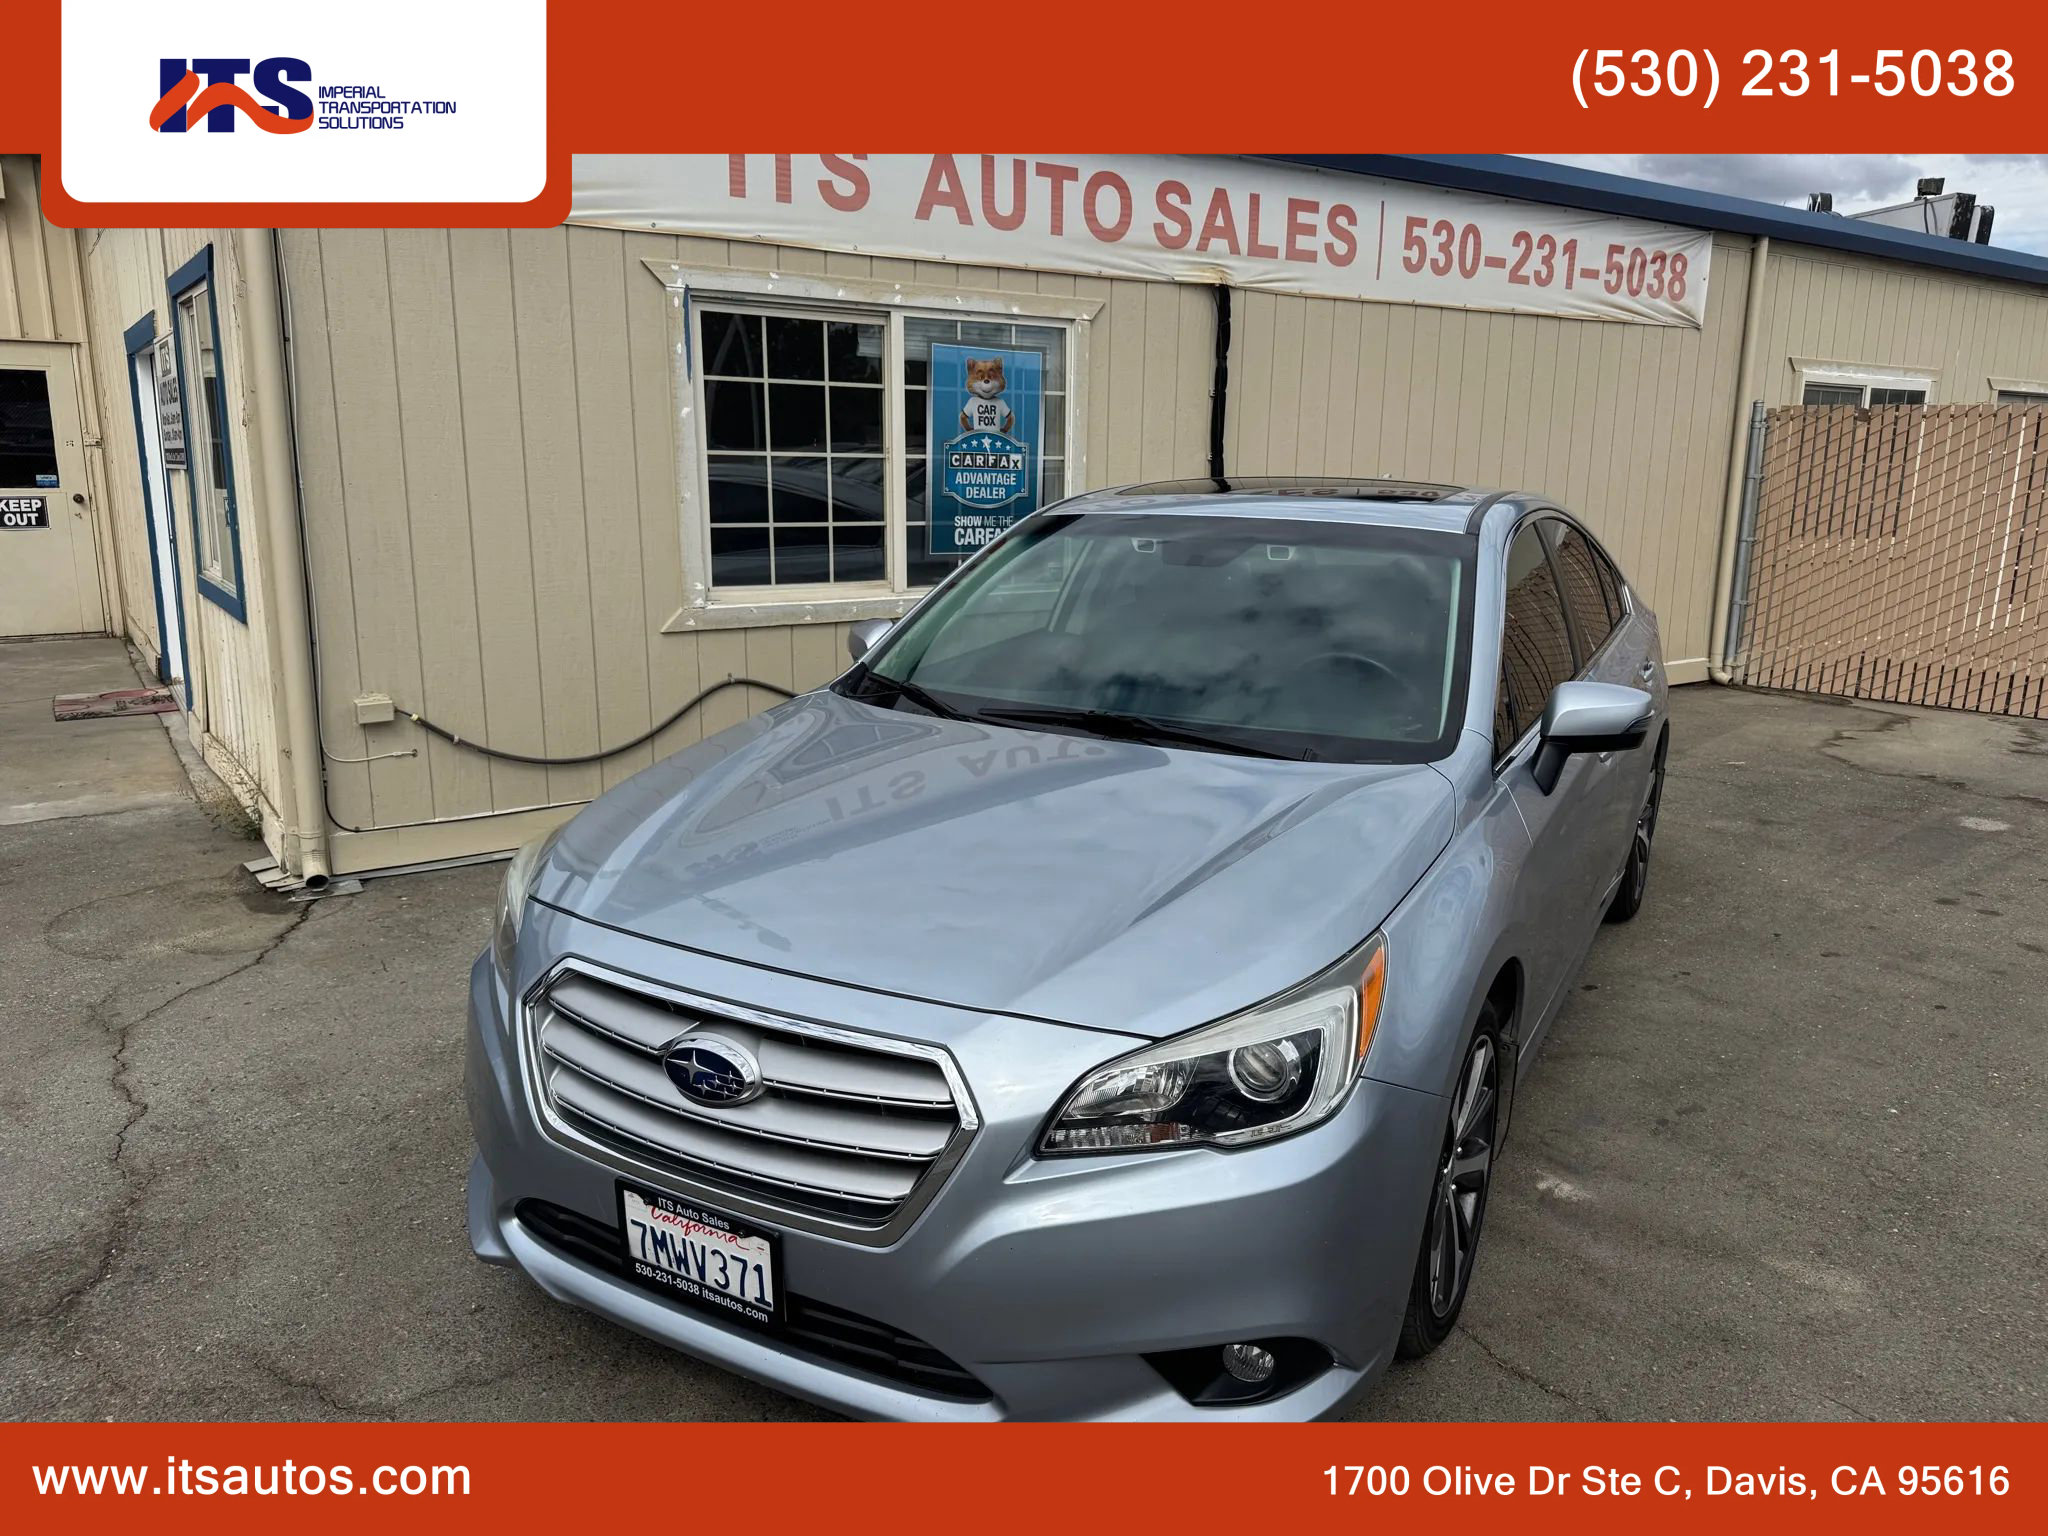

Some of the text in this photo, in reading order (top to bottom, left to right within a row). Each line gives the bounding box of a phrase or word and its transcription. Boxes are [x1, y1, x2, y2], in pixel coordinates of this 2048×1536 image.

[914, 154, 1133, 243] AUTO
[1155, 180, 1357, 267] SALES
[1402, 215, 1688, 302] 530-231-5038
[977, 404, 997, 416] CAR
[978, 416, 996, 427] FOX
[950, 453, 1021, 470] CARFAX
[955, 472, 1017, 486] ADVANTAGE
[966, 486, 1006, 500] DEALER
[0, 499, 42, 512] KEEP
[3, 513, 39, 526] OUT
[954, 515, 1014, 527] SHOW ME THE
[954, 527, 1007, 546] CARF
[657, 1197, 674, 1211] ITS
[676, 1204, 700, 1220] Auto
[701, 1212, 730, 1230] Sales
[650, 1205, 751, 1251] California
[630, 1218, 773, 1309] 7MWV371
[635, 1262, 769, 1324] 530-231-5038 itsautos.com
